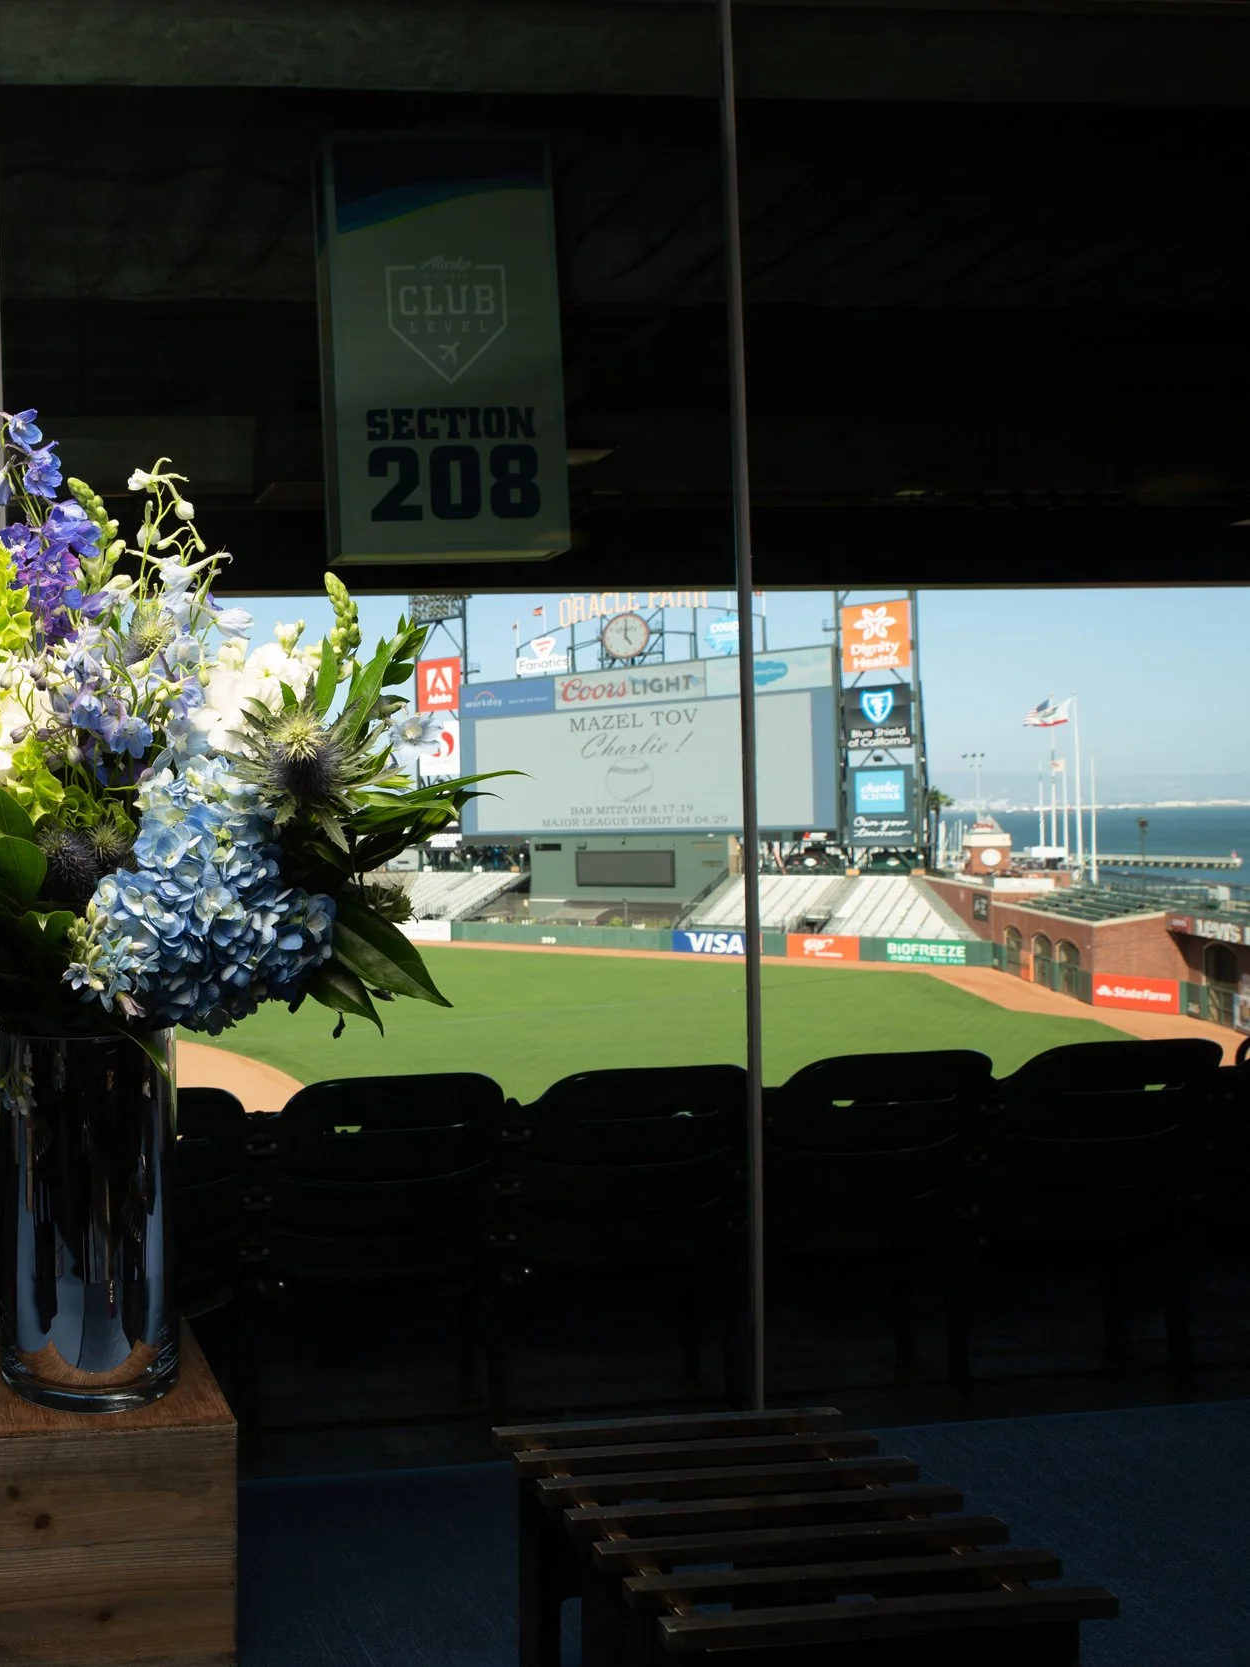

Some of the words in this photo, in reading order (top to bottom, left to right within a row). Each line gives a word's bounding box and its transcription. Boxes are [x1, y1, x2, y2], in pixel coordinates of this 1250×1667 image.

[419, 255, 471, 270] Alaska
[398, 285, 495, 316] CLUB
[410, 320, 488, 333] LEVEL
[366, 407, 535, 440] SECTION
[368, 444, 541, 522] 208
[559, 592, 640, 627] ORACLE
[850, 641, 900, 657] Dignity
[519, 656, 569, 671] Fanatics
[853, 655, 899, 669] Health
[561, 678, 627, 703] Coors
[630, 675, 692, 696] LIGHT
[427, 694, 453, 705] Adobe
[465, 698, 503, 708] workday
[569, 713, 643, 732] MAZEL
[650, 708, 698, 726] TOV
[851, 729, 873, 738] Blue
[874, 727, 906, 737] Shield
[848, 739, 859, 748] of
[860, 736, 911, 746] California
[570, 806, 591, 816] BAR
[596, 805, 647, 816] MITZVAH
[542, 818, 580, 828] MAJOR
[583, 817, 628, 827] LEAGUE
[632, 816, 673, 826] DEBUT
[685, 932, 745, 954] VISA
